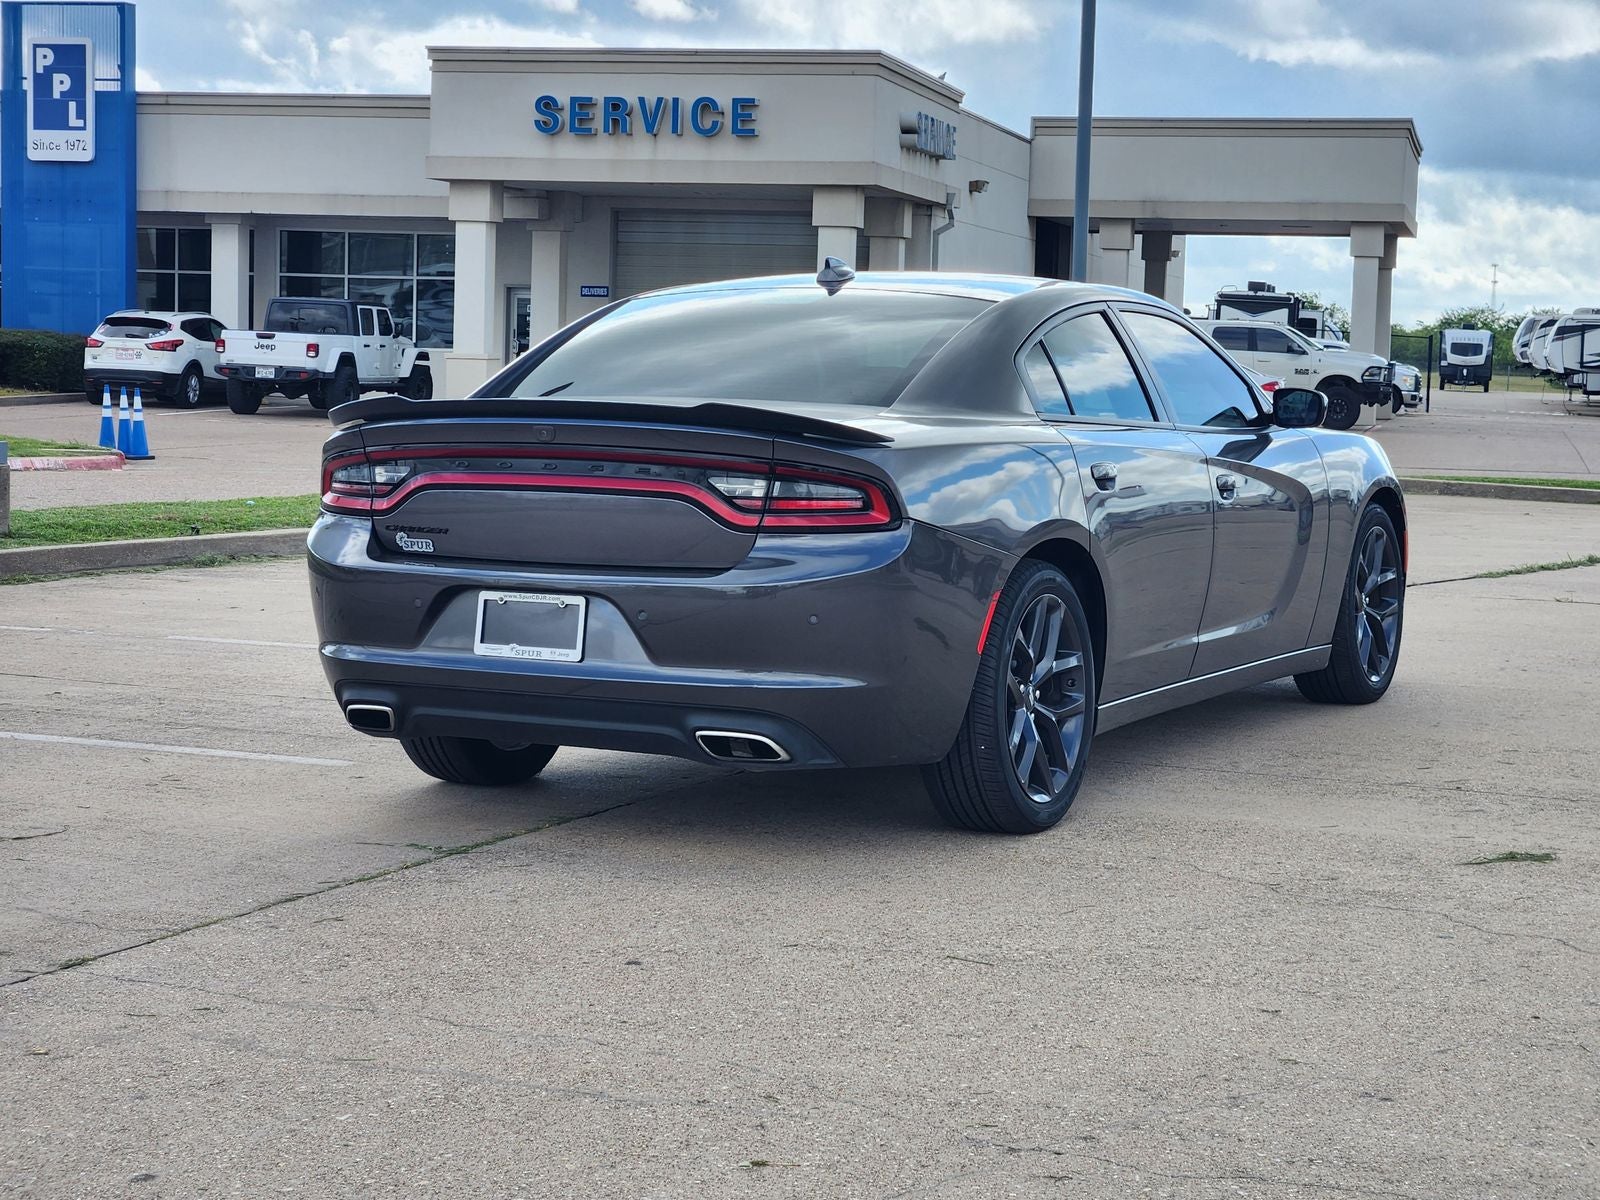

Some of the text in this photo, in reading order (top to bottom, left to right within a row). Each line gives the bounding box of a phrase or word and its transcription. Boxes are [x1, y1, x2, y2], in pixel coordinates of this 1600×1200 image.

[36, 47, 85, 128] PPL
[533, 94, 760, 138] SERVICE
[32, 138, 88, 151] Since 1972
[581, 287, 608, 296] DELIVERIES
[254, 342, 276, 352] Jeep
[403, 540, 433, 551] SPUR
[514, 649, 543, 658] SPUR
